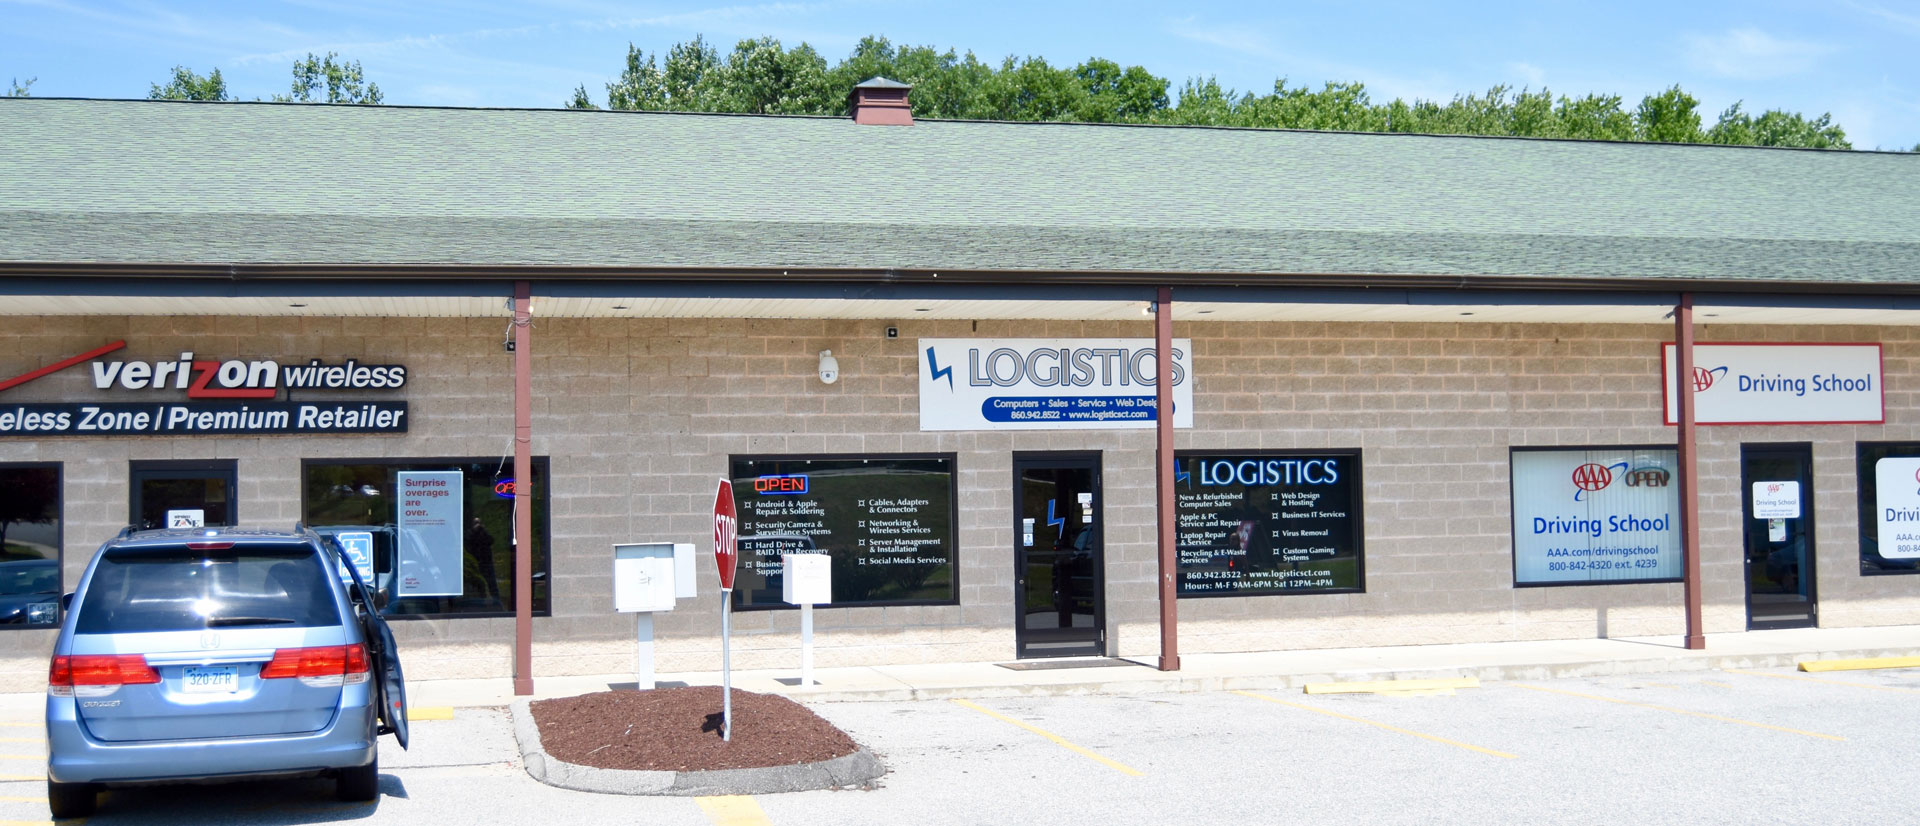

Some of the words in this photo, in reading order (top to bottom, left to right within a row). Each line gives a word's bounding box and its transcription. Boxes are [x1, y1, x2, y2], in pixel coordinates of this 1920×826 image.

[969, 348, 1185, 387] LOGISTICS
[92, 352, 280, 398] verizon
[284, 361, 405, 388] wireless
[1739, 374, 1805, 396] Driving
[1812, 374, 1871, 392] School
[994, 399, 1039, 409] Computers
[1048, 399, 1069, 408] Sales
[1077, 399, 1107, 408] Service
[1115, 399, 1134, 408] Web
[1136, 399, 1159, 409] Desig
[77, 407, 150, 431] Zone
[167, 406, 289, 431] Premium
[298, 405, 404, 429] Retailer
[1010, 411, 1061, 420] 860.942.8522
[1069, 410, 1148, 421] www.logisticsct.com
[1200, 460, 1338, 485] LOGISTICS
[1575, 464, 1609, 490] AAA
[405, 478, 446, 488] Surprise
[1625, 471, 1670, 487] OPEN
[754, 478, 804, 491] OPEN
[405, 490, 449, 498] overages
[1298, 492, 1320, 501] Design
[755, 500, 785, 508] Android
[787, 500, 794, 508] &
[796, 500, 818, 509] Apple
[868, 499, 895, 507] Cables,
[897, 498, 929, 507] Adapters
[1288, 499, 1314, 508] Hosting
[756, 509, 780, 517] Repair
[789, 507, 825, 516] Soldering
[1886, 507, 1920, 522] Drivi
[1179, 513, 1200, 521] Apple
[755, 522, 787, 530] Security
[869, 520, 911, 528] Networking
[1205, 519, 1219, 527] and
[1220, 519, 1241, 528] Repair
[1533, 516, 1601, 537] Driving
[1609, 513, 1669, 532] School
[715, 514, 736, 555] STOP
[755, 528, 800, 536] Surveillance
[802, 528, 832, 536] Systems
[1180, 532, 1204, 540] Laptop
[1205, 531, 1226, 540] Repair
[756, 541, 774, 549] Hard
[894, 538, 941, 547] Management
[1187, 538, 1212, 546] Service
[796, 548, 829, 556] Recovery
[1181, 550, 1212, 558] Recycling
[1309, 547, 1335, 555] Gaming
[1547, 545, 1659, 558] AAA.com/drivingschool
[917, 556, 947, 564] Services
[1283, 554, 1309, 562] Systems
[1549, 561, 1612, 571] 800-842-4320
[1614, 560, 1632, 569] ext.
[1635, 559, 1657, 569] 4239
[342, 567, 371, 577] PAING
[756, 569, 783, 577] Suppor
[1186, 571, 1241, 580] 860.942.8522
[1249, 569, 1331, 579] www.logisticsct.com
[1184, 582, 1213, 590] Hours:
[1232, 581, 1272, 589] 9AM-6PM
[1274, 580, 1287, 588] Sat
